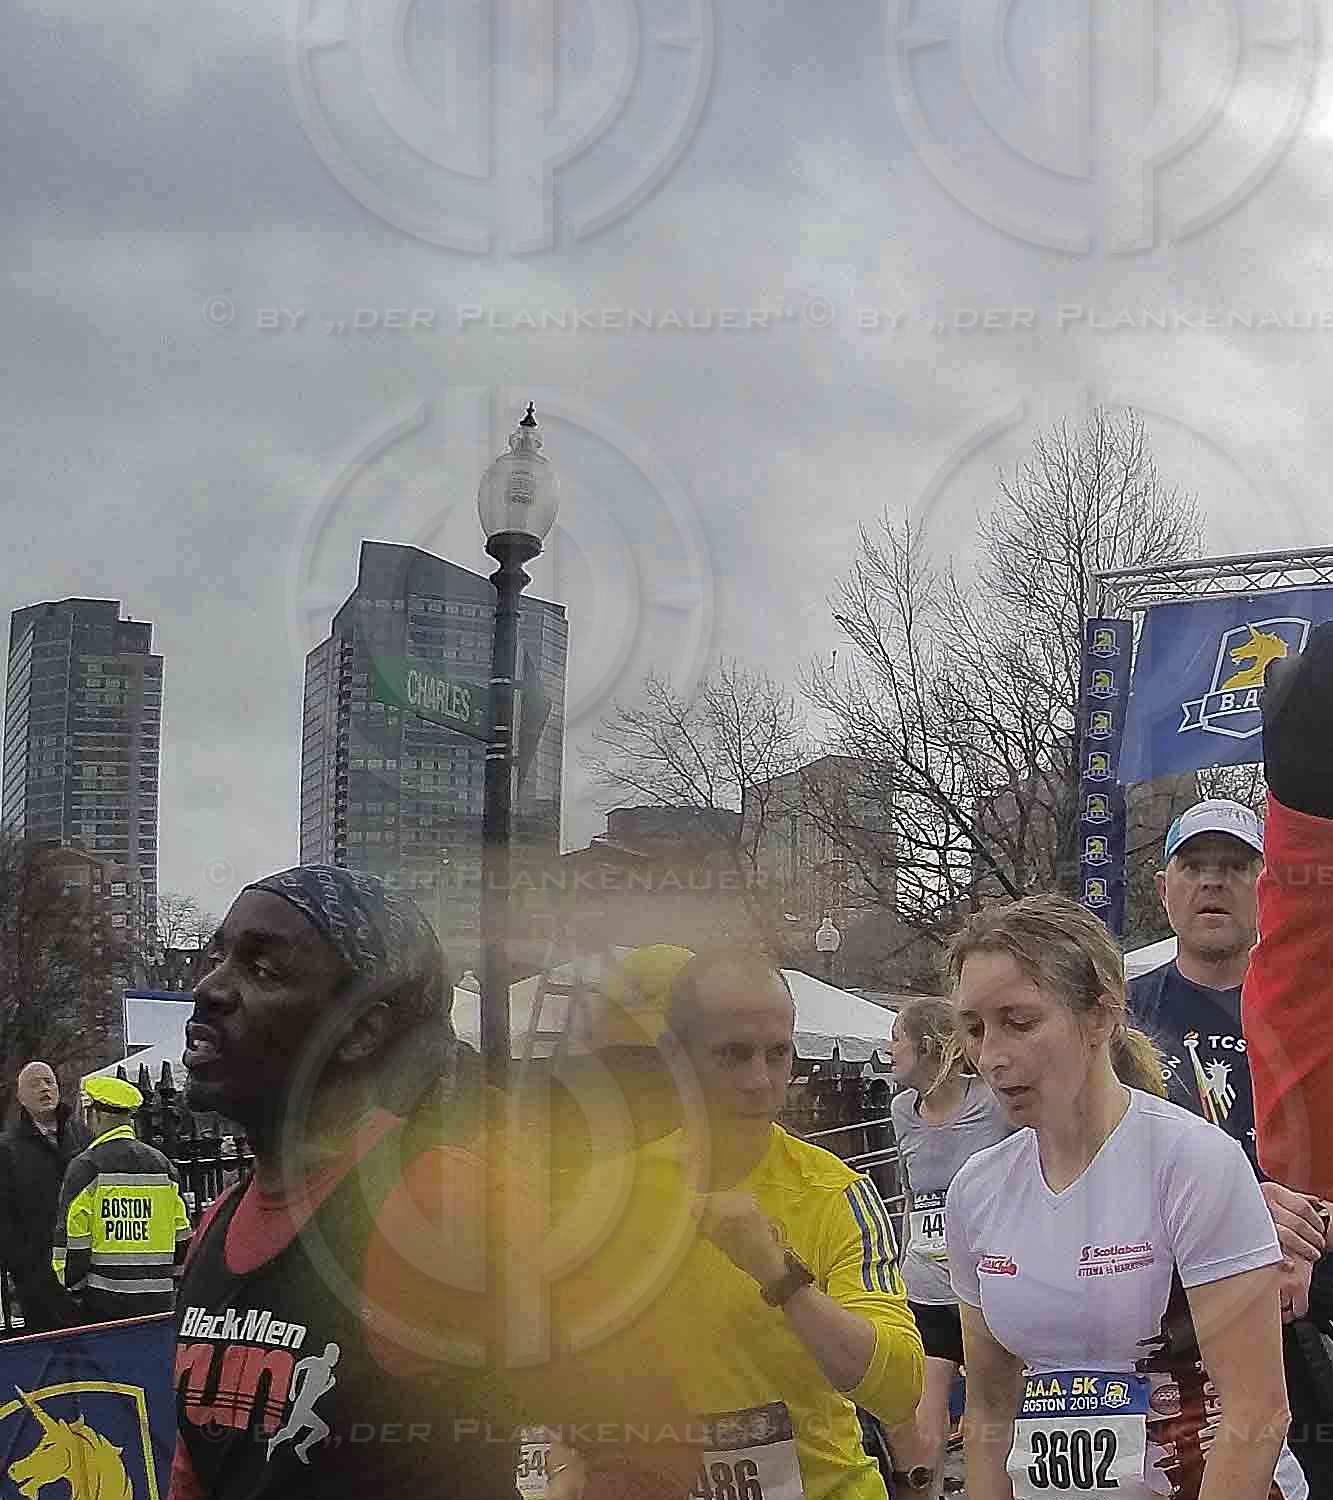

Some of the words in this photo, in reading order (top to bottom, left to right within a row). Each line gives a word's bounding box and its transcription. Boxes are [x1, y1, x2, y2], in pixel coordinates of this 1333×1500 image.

[406, 669, 471, 721] CHARLES
[101, 1197, 151, 1218] BOSTON
[104, 1219, 149, 1241] POLICE
[1026, 1378, 1067, 1398] B.A.A.
[1072, 1377, 1099, 1396] 5K
[1022, 1397, 1066, 1413] BOSTON
[1070, 1395, 1099, 1411] 2019
[1028, 1428, 1120, 1490] 3602
